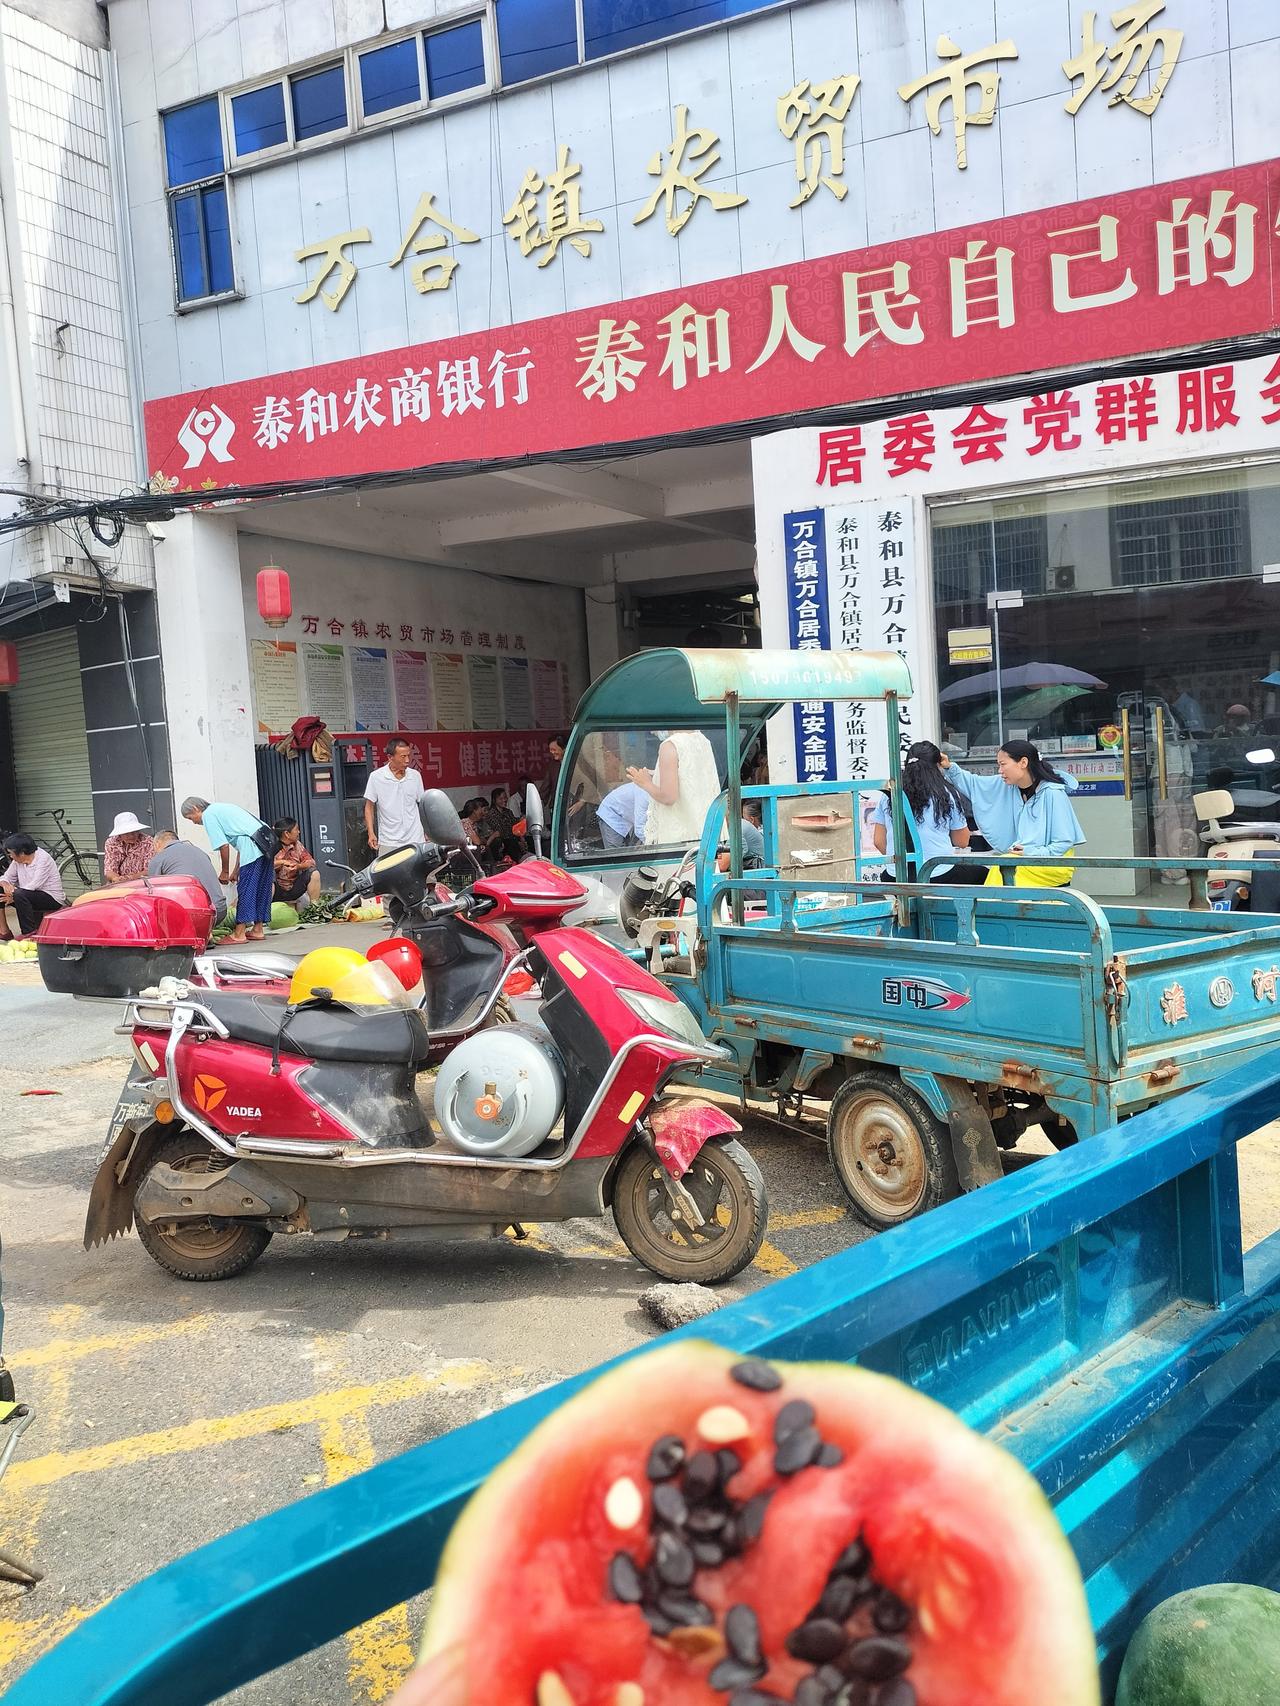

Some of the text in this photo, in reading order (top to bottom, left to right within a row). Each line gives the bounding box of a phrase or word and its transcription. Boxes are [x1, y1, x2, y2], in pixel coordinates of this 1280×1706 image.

[294, 0, 1185, 313] 万合镇农贸市场
[574, 190, 1280, 404] 泰和人民自己的
[251, 347, 536, 451] 泰和农商银行
[226, 1106, 262, 1117] YADEA
